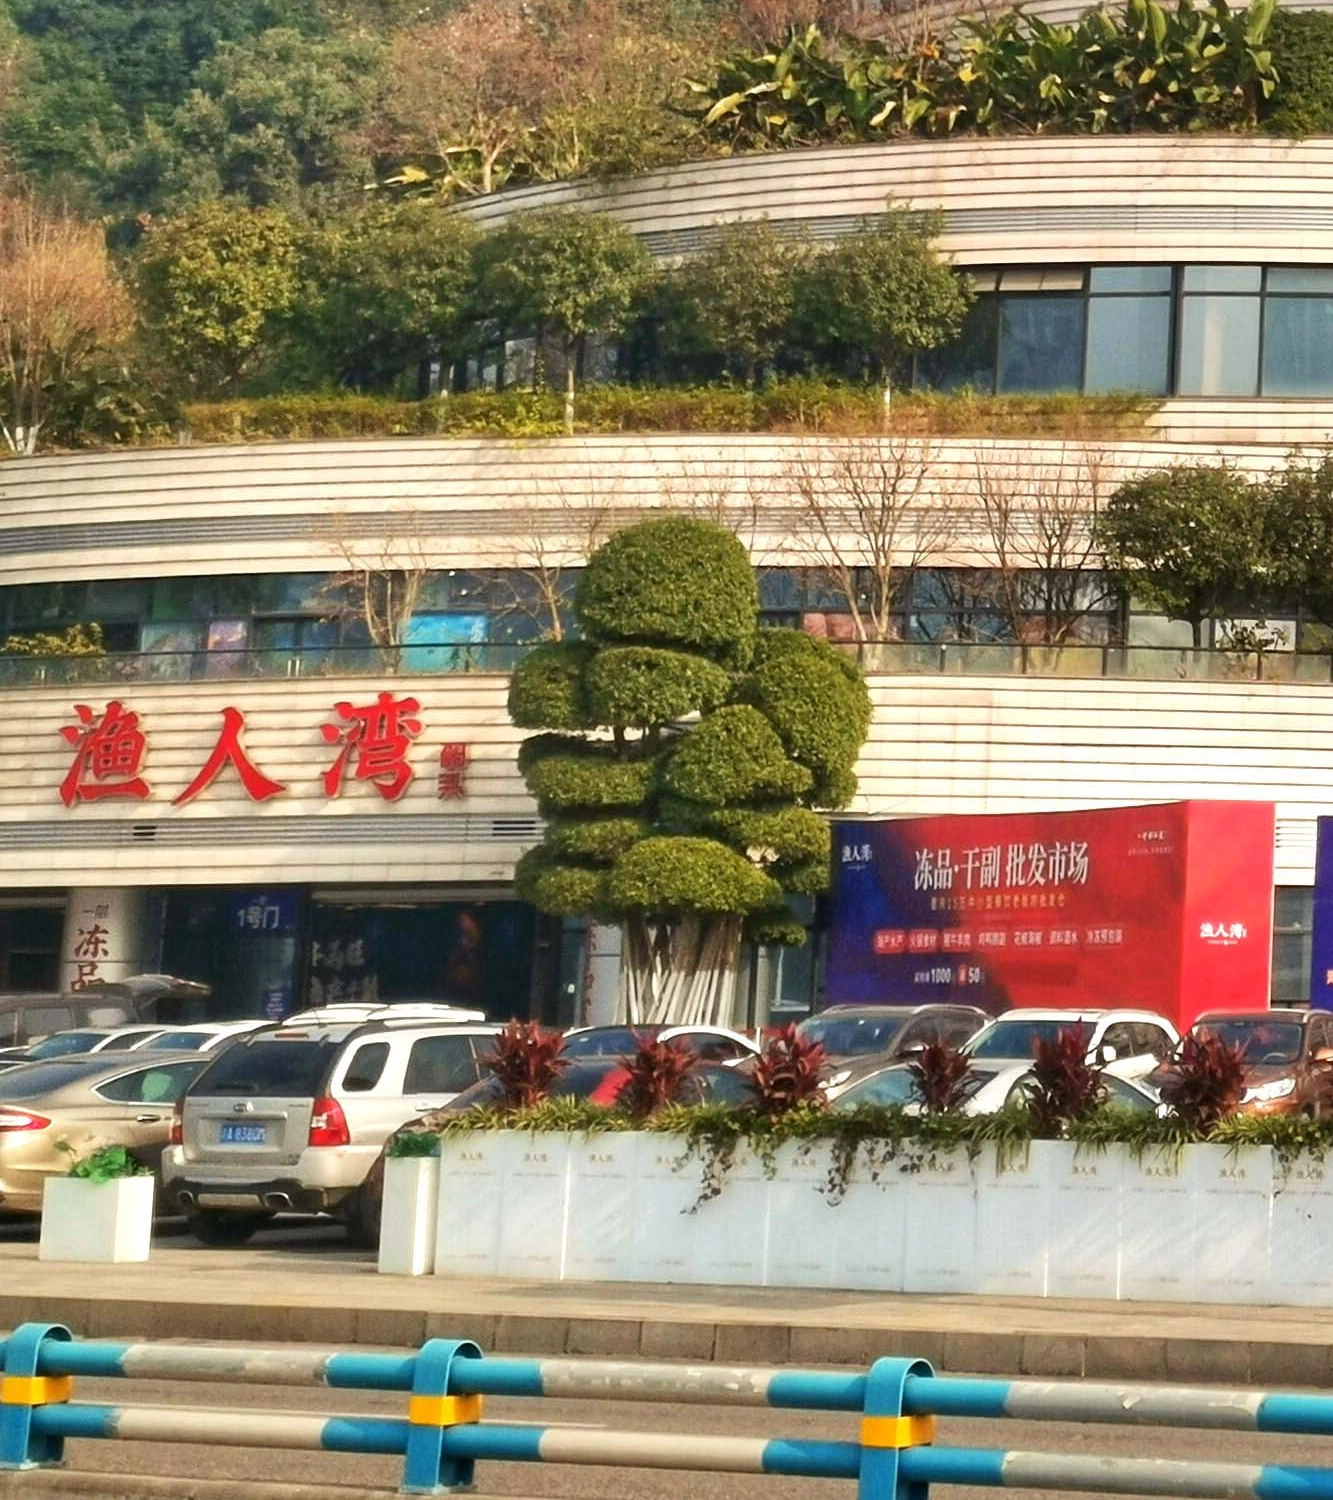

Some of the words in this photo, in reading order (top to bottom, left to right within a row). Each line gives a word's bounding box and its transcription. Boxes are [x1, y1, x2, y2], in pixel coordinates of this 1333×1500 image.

[58, 691, 424, 808] 渔人湾
[1006, 841, 1088, 887] 批发市场
[238, 906, 279, 929] 1号门
